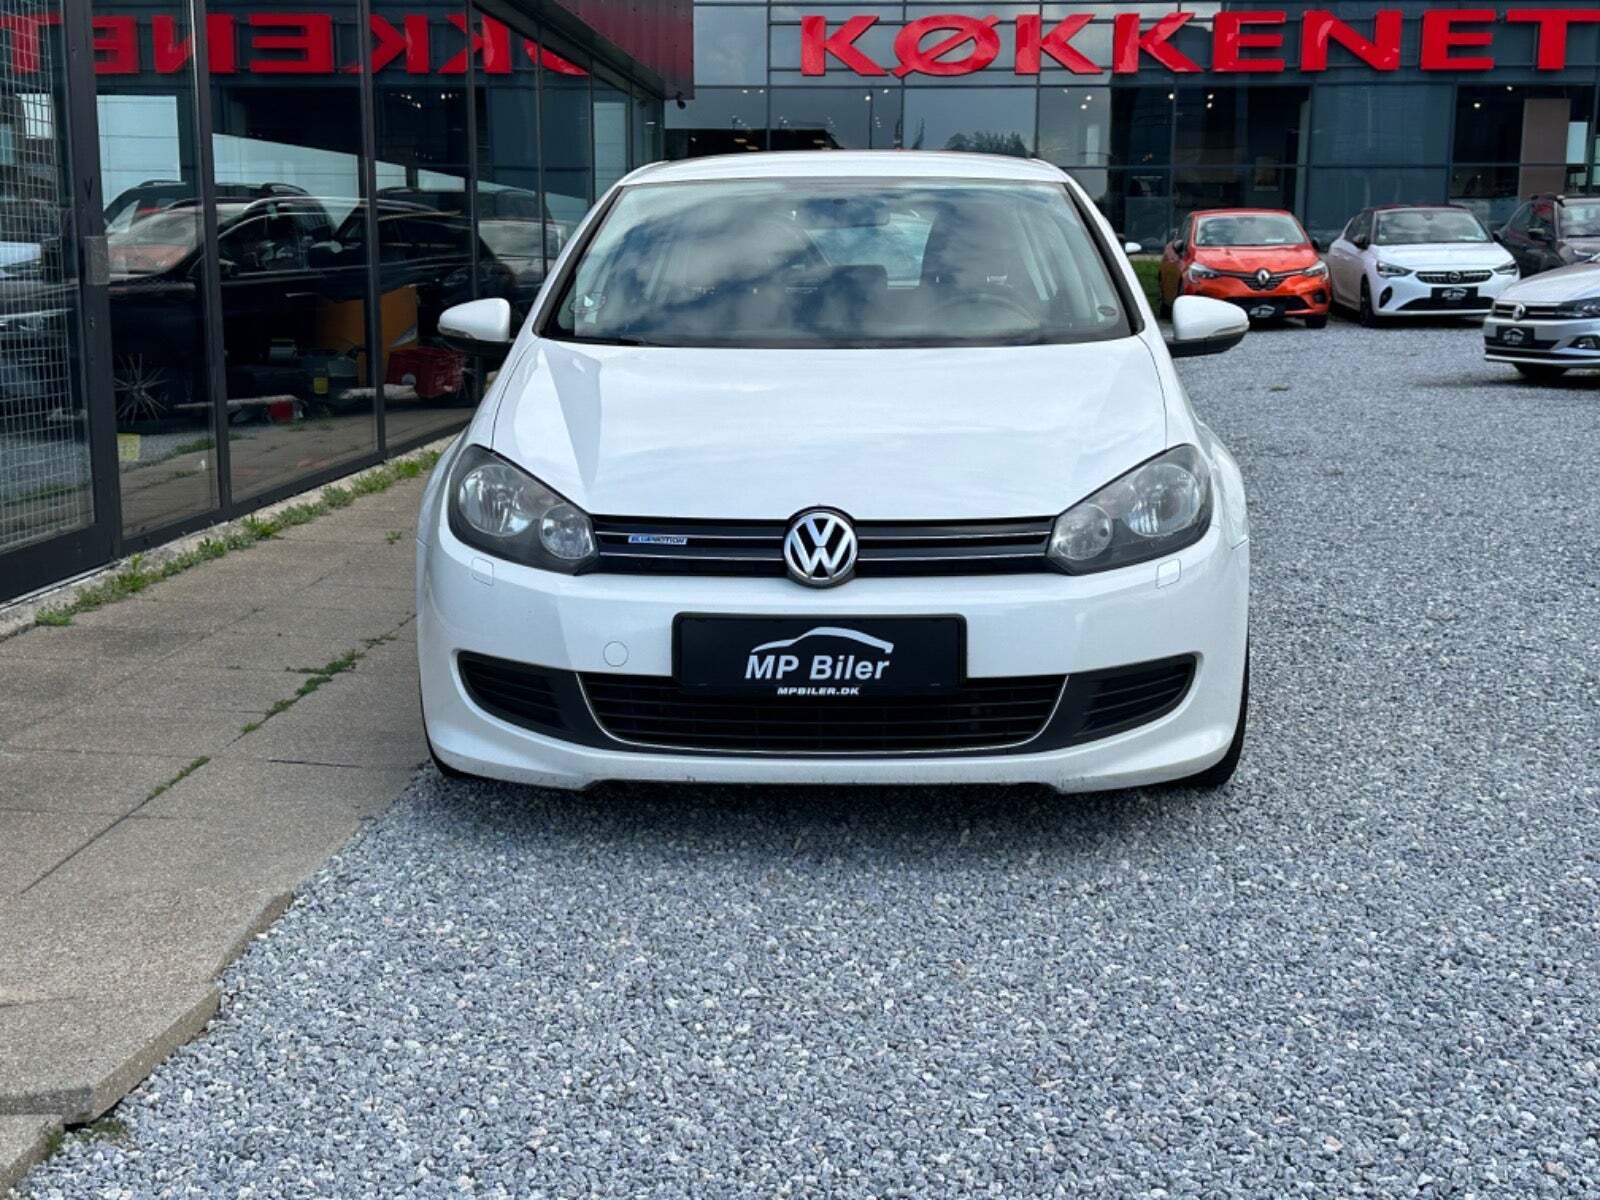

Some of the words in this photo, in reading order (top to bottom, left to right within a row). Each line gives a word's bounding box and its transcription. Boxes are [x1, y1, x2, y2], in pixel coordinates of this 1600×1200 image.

[801, 8, 1600, 79] KØKKENET
[784, 512, 858, 584] VW
[744, 654, 799, 680] MP
[809, 654, 890, 680] Biler
[776, 686, 860, 696] MPBILER.DK
